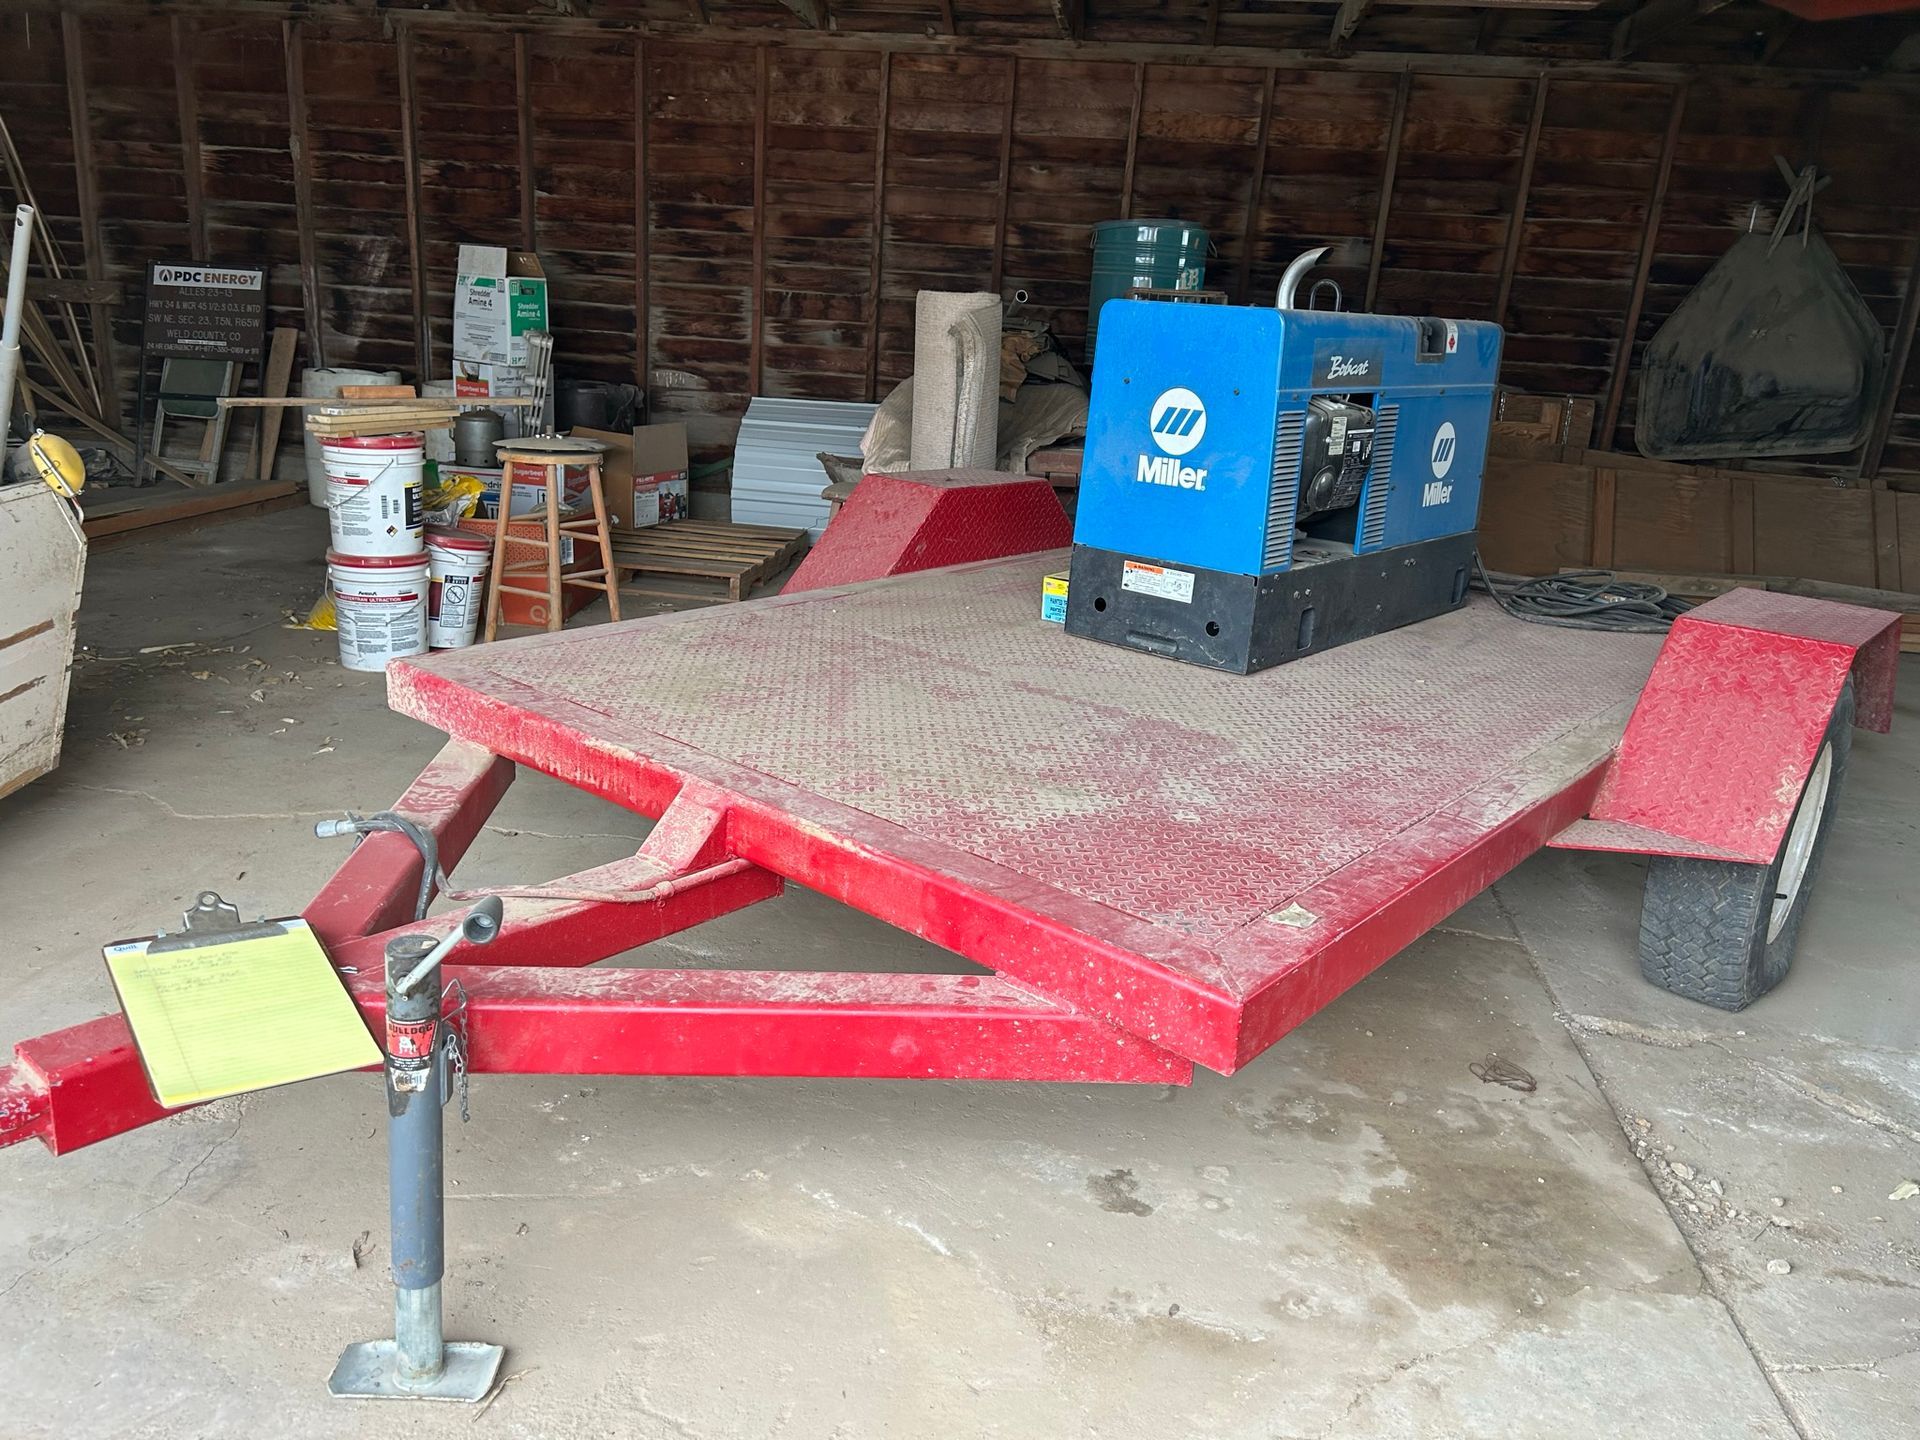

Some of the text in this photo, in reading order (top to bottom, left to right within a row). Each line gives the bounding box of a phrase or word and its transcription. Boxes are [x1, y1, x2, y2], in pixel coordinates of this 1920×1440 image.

[174, 271, 256, 285] PDC ENERGY
[179, 287, 206, 297] ALLES
[149, 299, 163, 309] HWY
[164, 300, 174, 309] 34
[468, 297, 493, 308] Amine 4
[517, 310, 536, 318] Amine
[148, 313, 162, 322] SW
[235, 318, 261, 328] R65W
[167, 329, 190, 338] WELD
[229, 332, 241, 341] CO
[1327, 355, 1369, 380] Bobcat
[513, 467, 544, 477] Sugarbeet
[1136, 453, 1207, 492] Miller
[1422, 481, 1453, 507] Miller
[113, 944, 137, 952] Quill
[389, 1023, 433, 1035] BULLDOG
